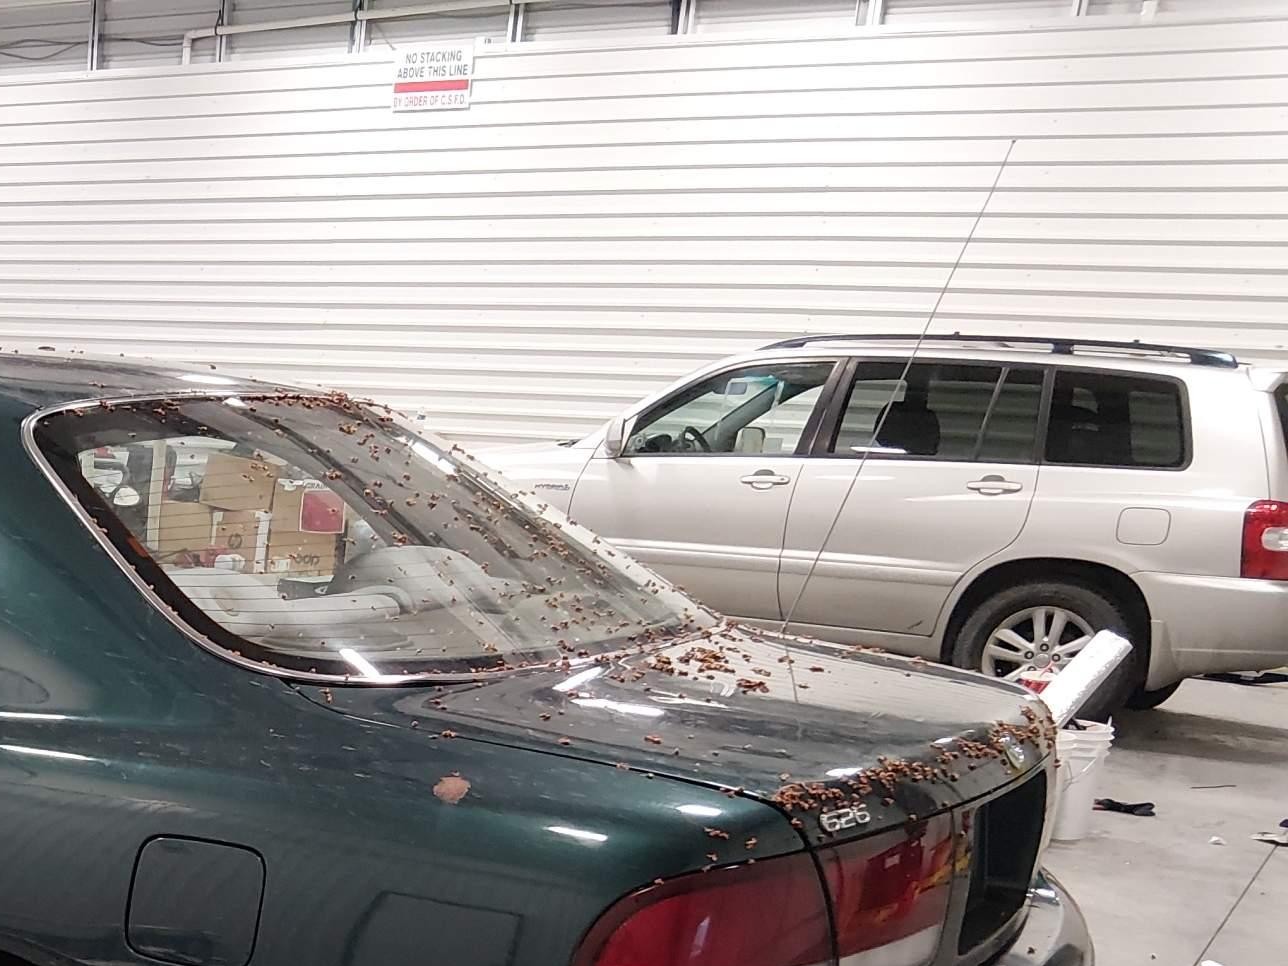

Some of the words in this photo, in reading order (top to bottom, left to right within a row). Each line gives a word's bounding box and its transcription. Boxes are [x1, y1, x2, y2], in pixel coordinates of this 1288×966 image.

[406, 53, 418, 64] NO
[420, 50, 462, 64] STACKING
[397, 66, 425, 78] ABOVE
[428, 66, 446, 77] THIS
[449, 64, 468, 76] LINE
[393, 97, 402, 107] BY
[404, 95, 428, 107] ORDER
[429, 95, 439, 106] OF
[819, 803, 871, 832] 626
